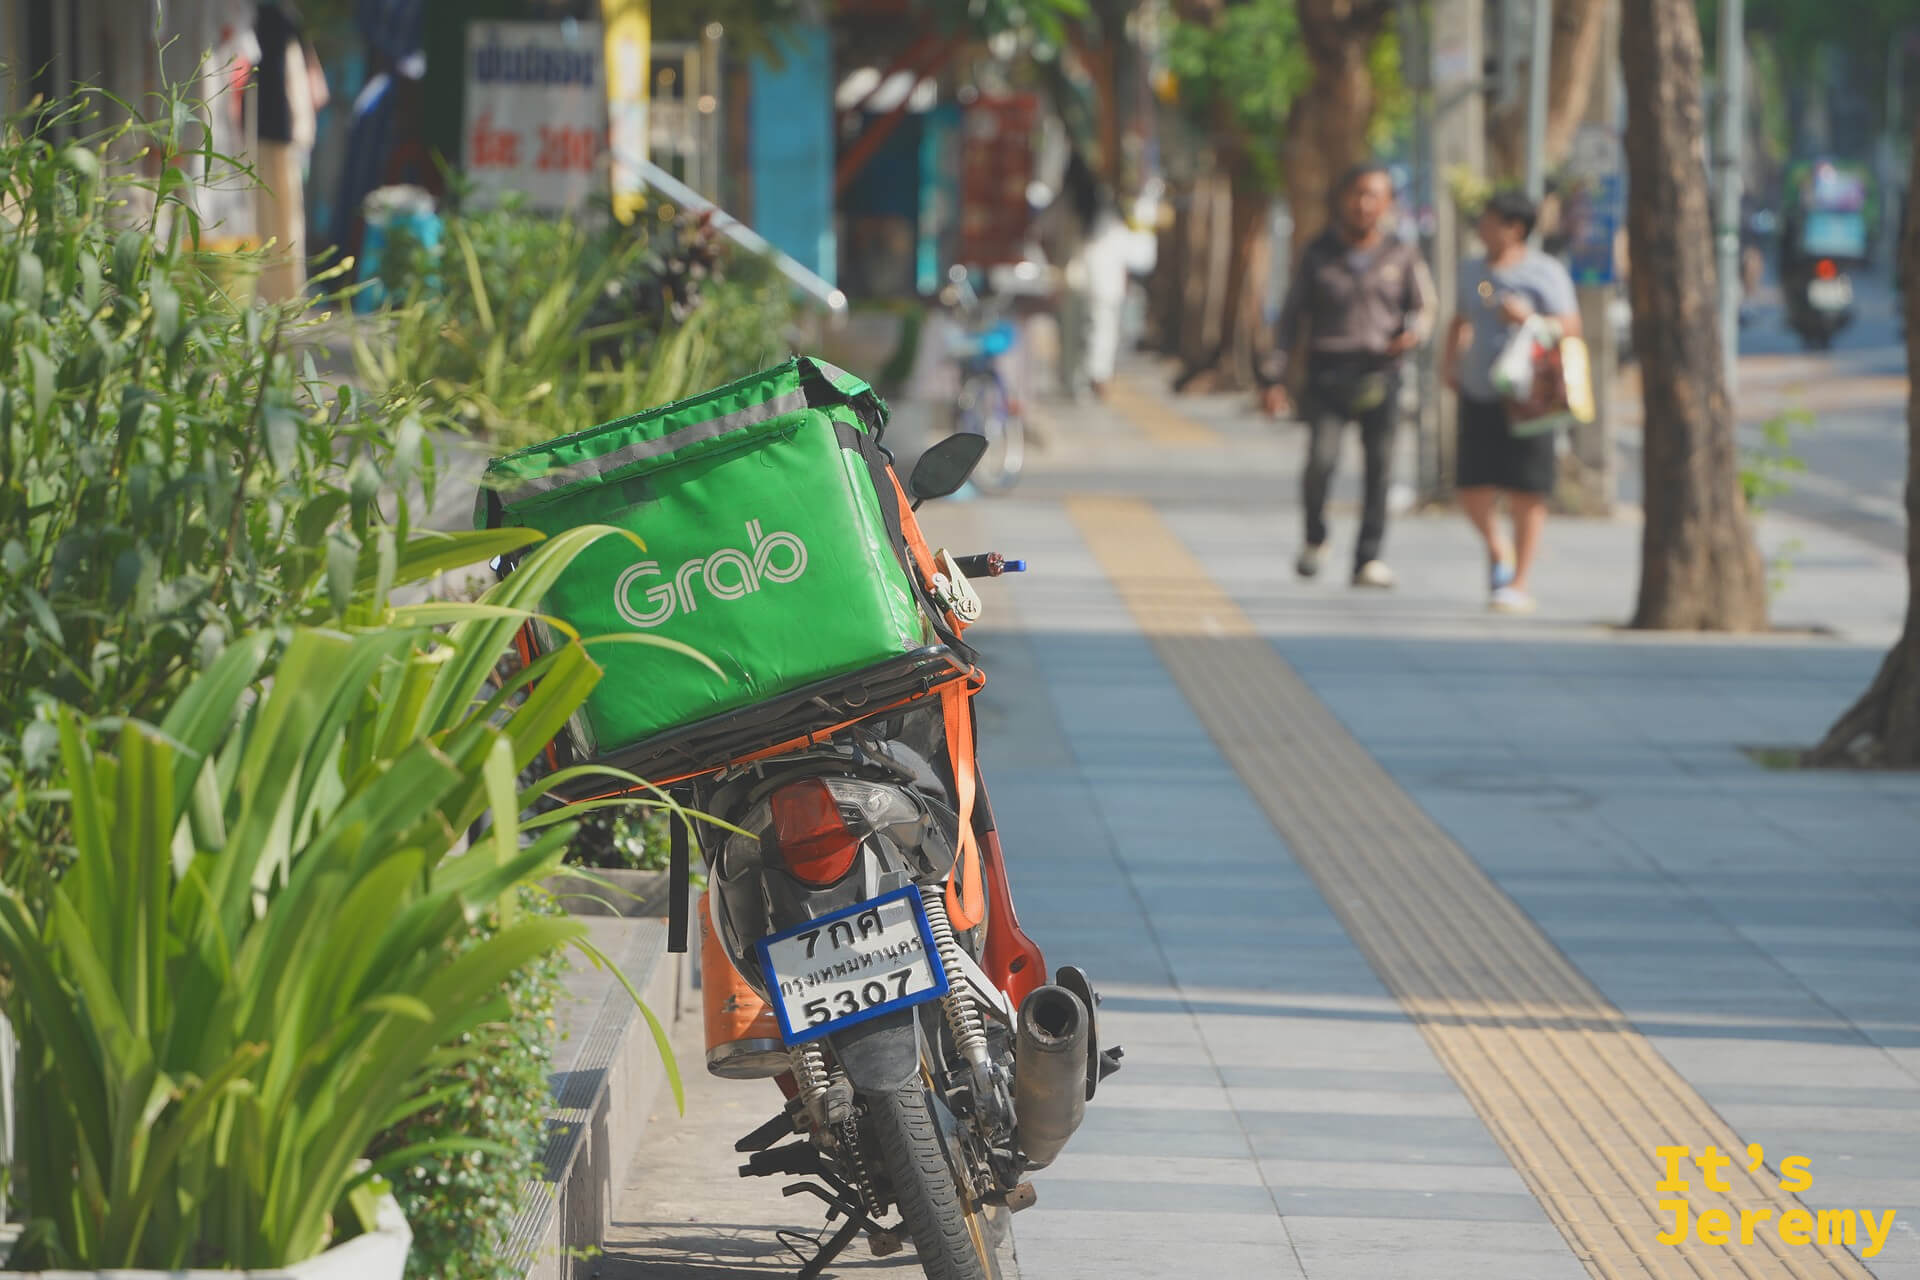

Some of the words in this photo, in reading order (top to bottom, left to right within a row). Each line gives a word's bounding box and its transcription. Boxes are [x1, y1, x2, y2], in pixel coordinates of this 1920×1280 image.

[614, 518, 808, 628] Grab
[780, 935, 923, 998] กรุงเทพมหานคร
[803, 967, 912, 1027] 5307
